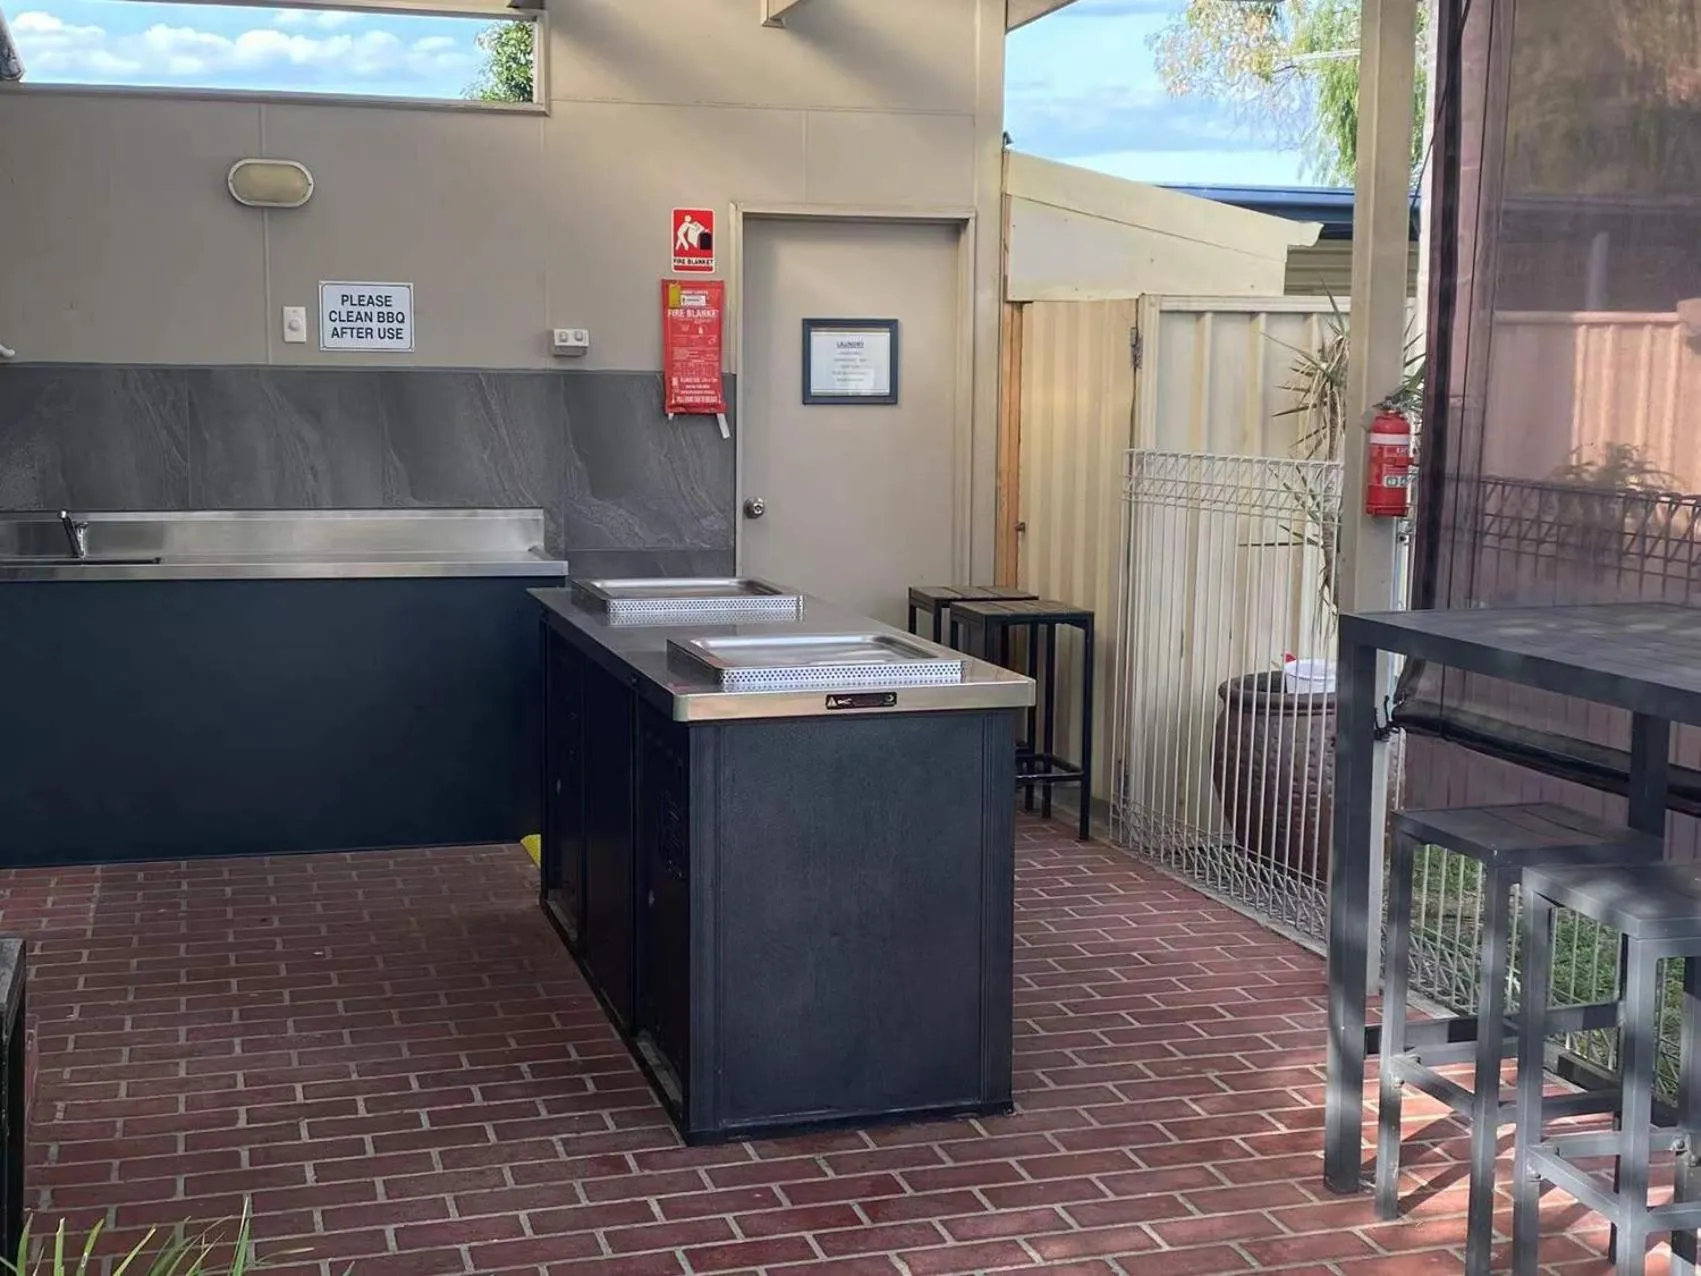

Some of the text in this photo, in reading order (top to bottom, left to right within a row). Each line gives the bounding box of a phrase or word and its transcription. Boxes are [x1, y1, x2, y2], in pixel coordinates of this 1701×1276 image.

[341, 294, 392, 307] PLEASE
[329, 310, 405, 324] CLEAN BBQ
[667, 308, 685, 318] FIRE
[331, 326, 404, 340] AFTER USE
